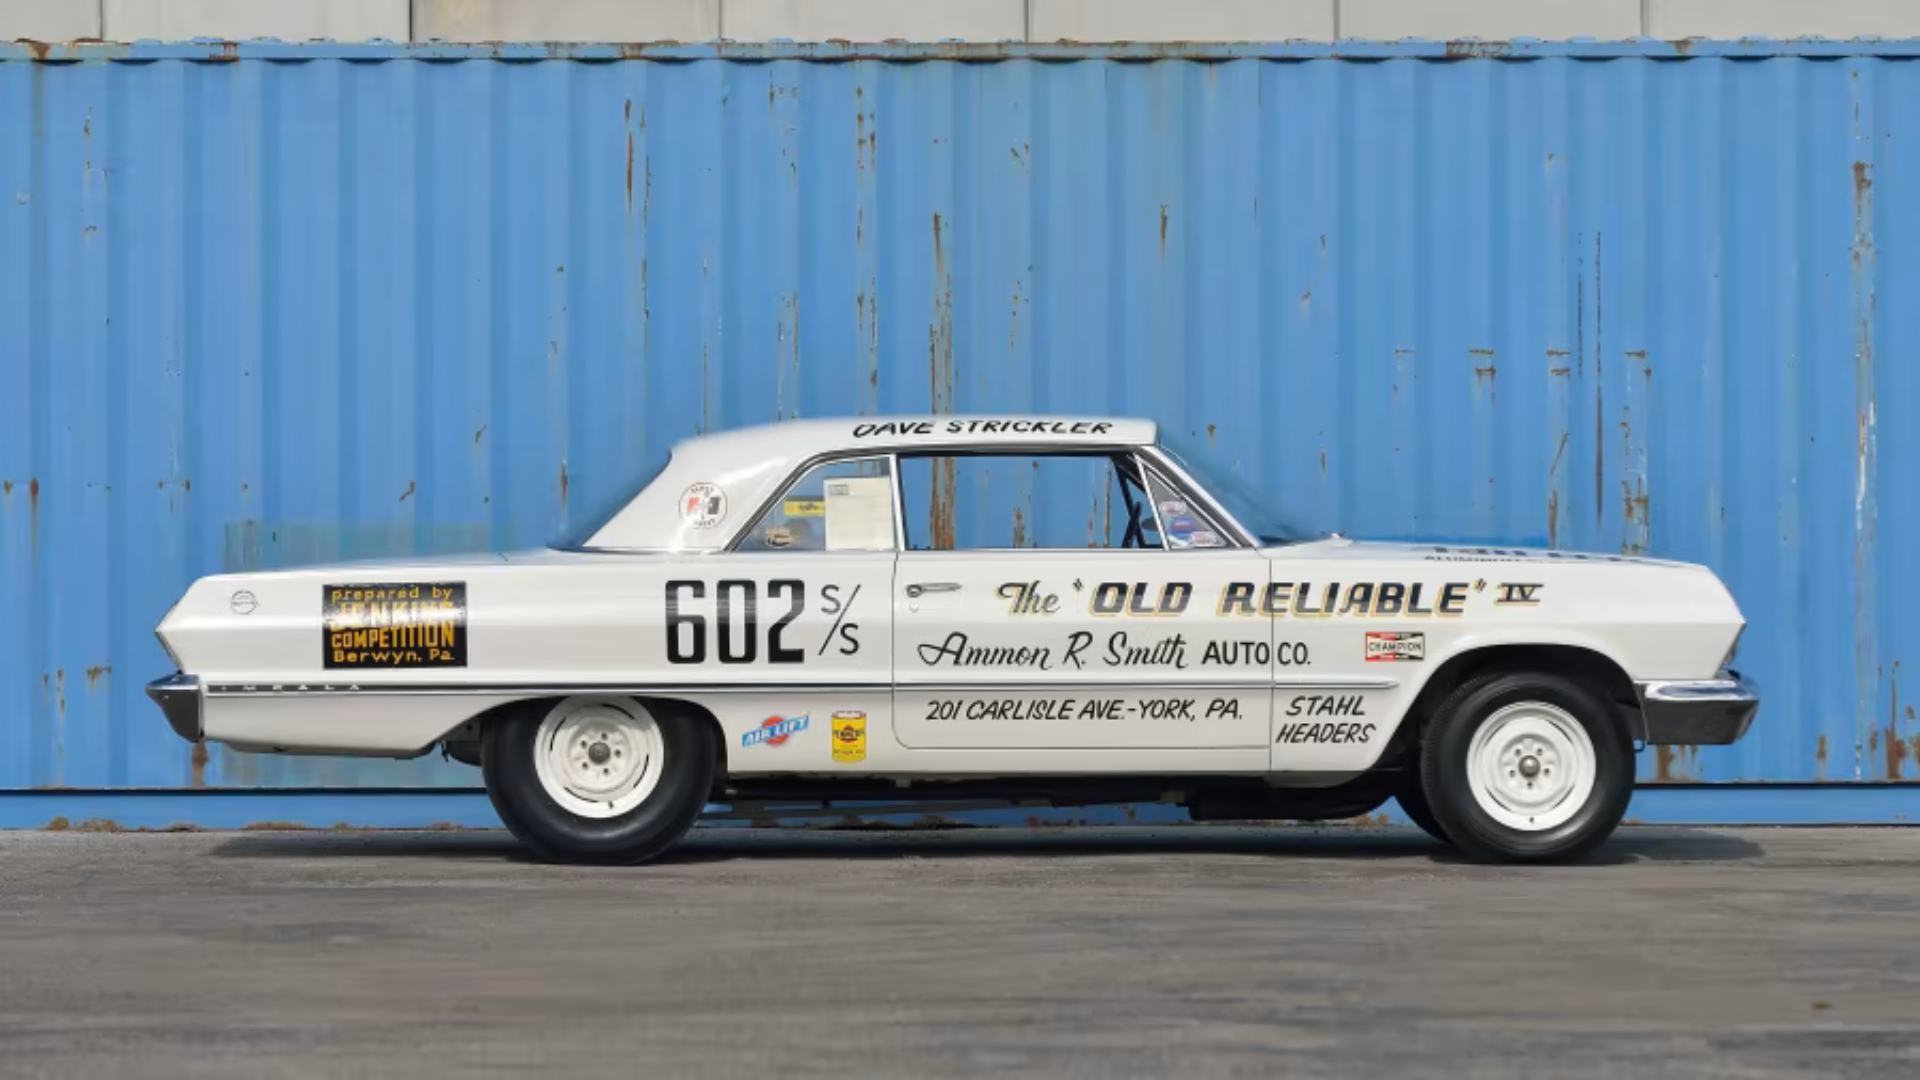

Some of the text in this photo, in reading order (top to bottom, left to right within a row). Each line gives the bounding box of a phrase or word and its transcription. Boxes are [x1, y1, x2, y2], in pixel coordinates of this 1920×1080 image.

[852, 420, 1113, 438] DAVE STRICKLER
[331, 586, 453, 603] prepared by
[995, 580, 1061, 616] The
[1494, 583, 1544, 606] IV
[665, 579, 805, 664] 602
[331, 622, 454, 648] COMPETITION
[917, 631, 1311, 670] Ammon R. Smith AUTO CO.
[1369, 642, 1421, 651] CHAMPION
[926, 700, 962, 721] 201
[966, 700, 1074, 721] CARLISLE
[1205, 699, 1242, 720] PA.
[1286, 695, 1365, 716] STAHL
[1275, 723, 1376, 743] HEADERS
